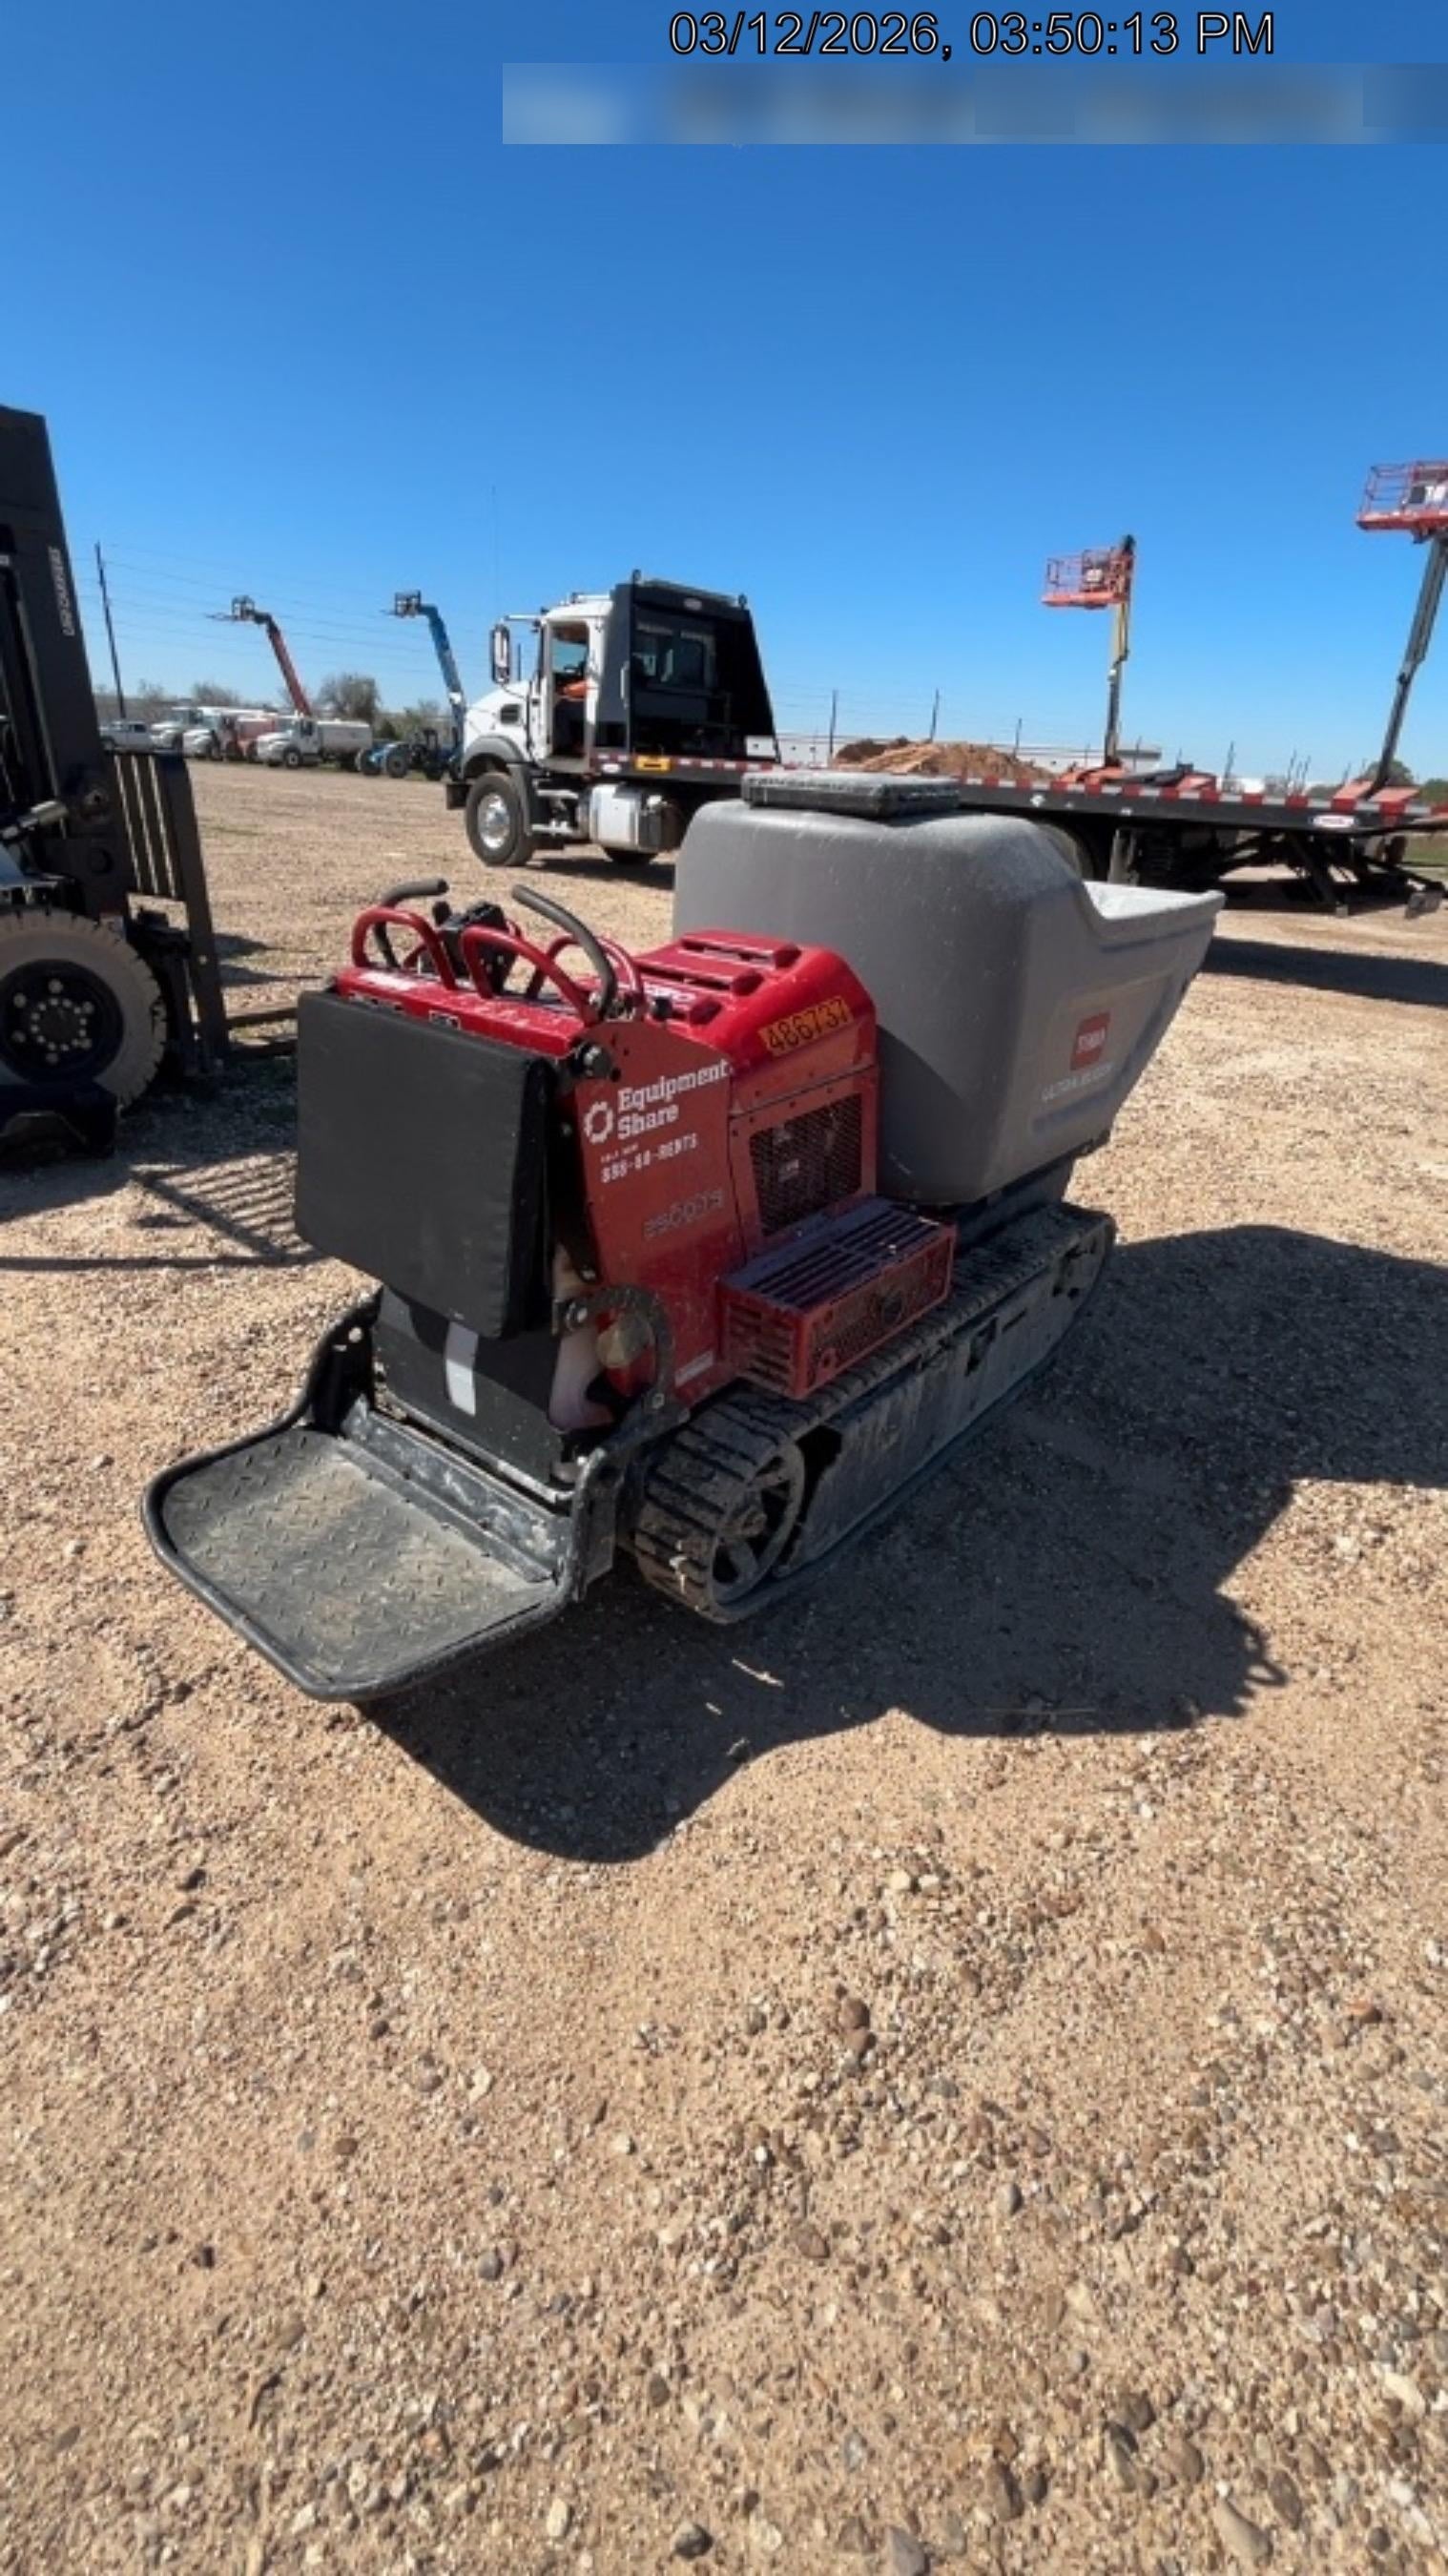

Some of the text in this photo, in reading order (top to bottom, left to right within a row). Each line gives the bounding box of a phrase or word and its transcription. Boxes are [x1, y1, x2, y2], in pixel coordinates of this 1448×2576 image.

[768, 997, 849, 1051] 486737
[617, 1058, 730, 1113] Equipment
[617, 1104, 680, 1140] Share
